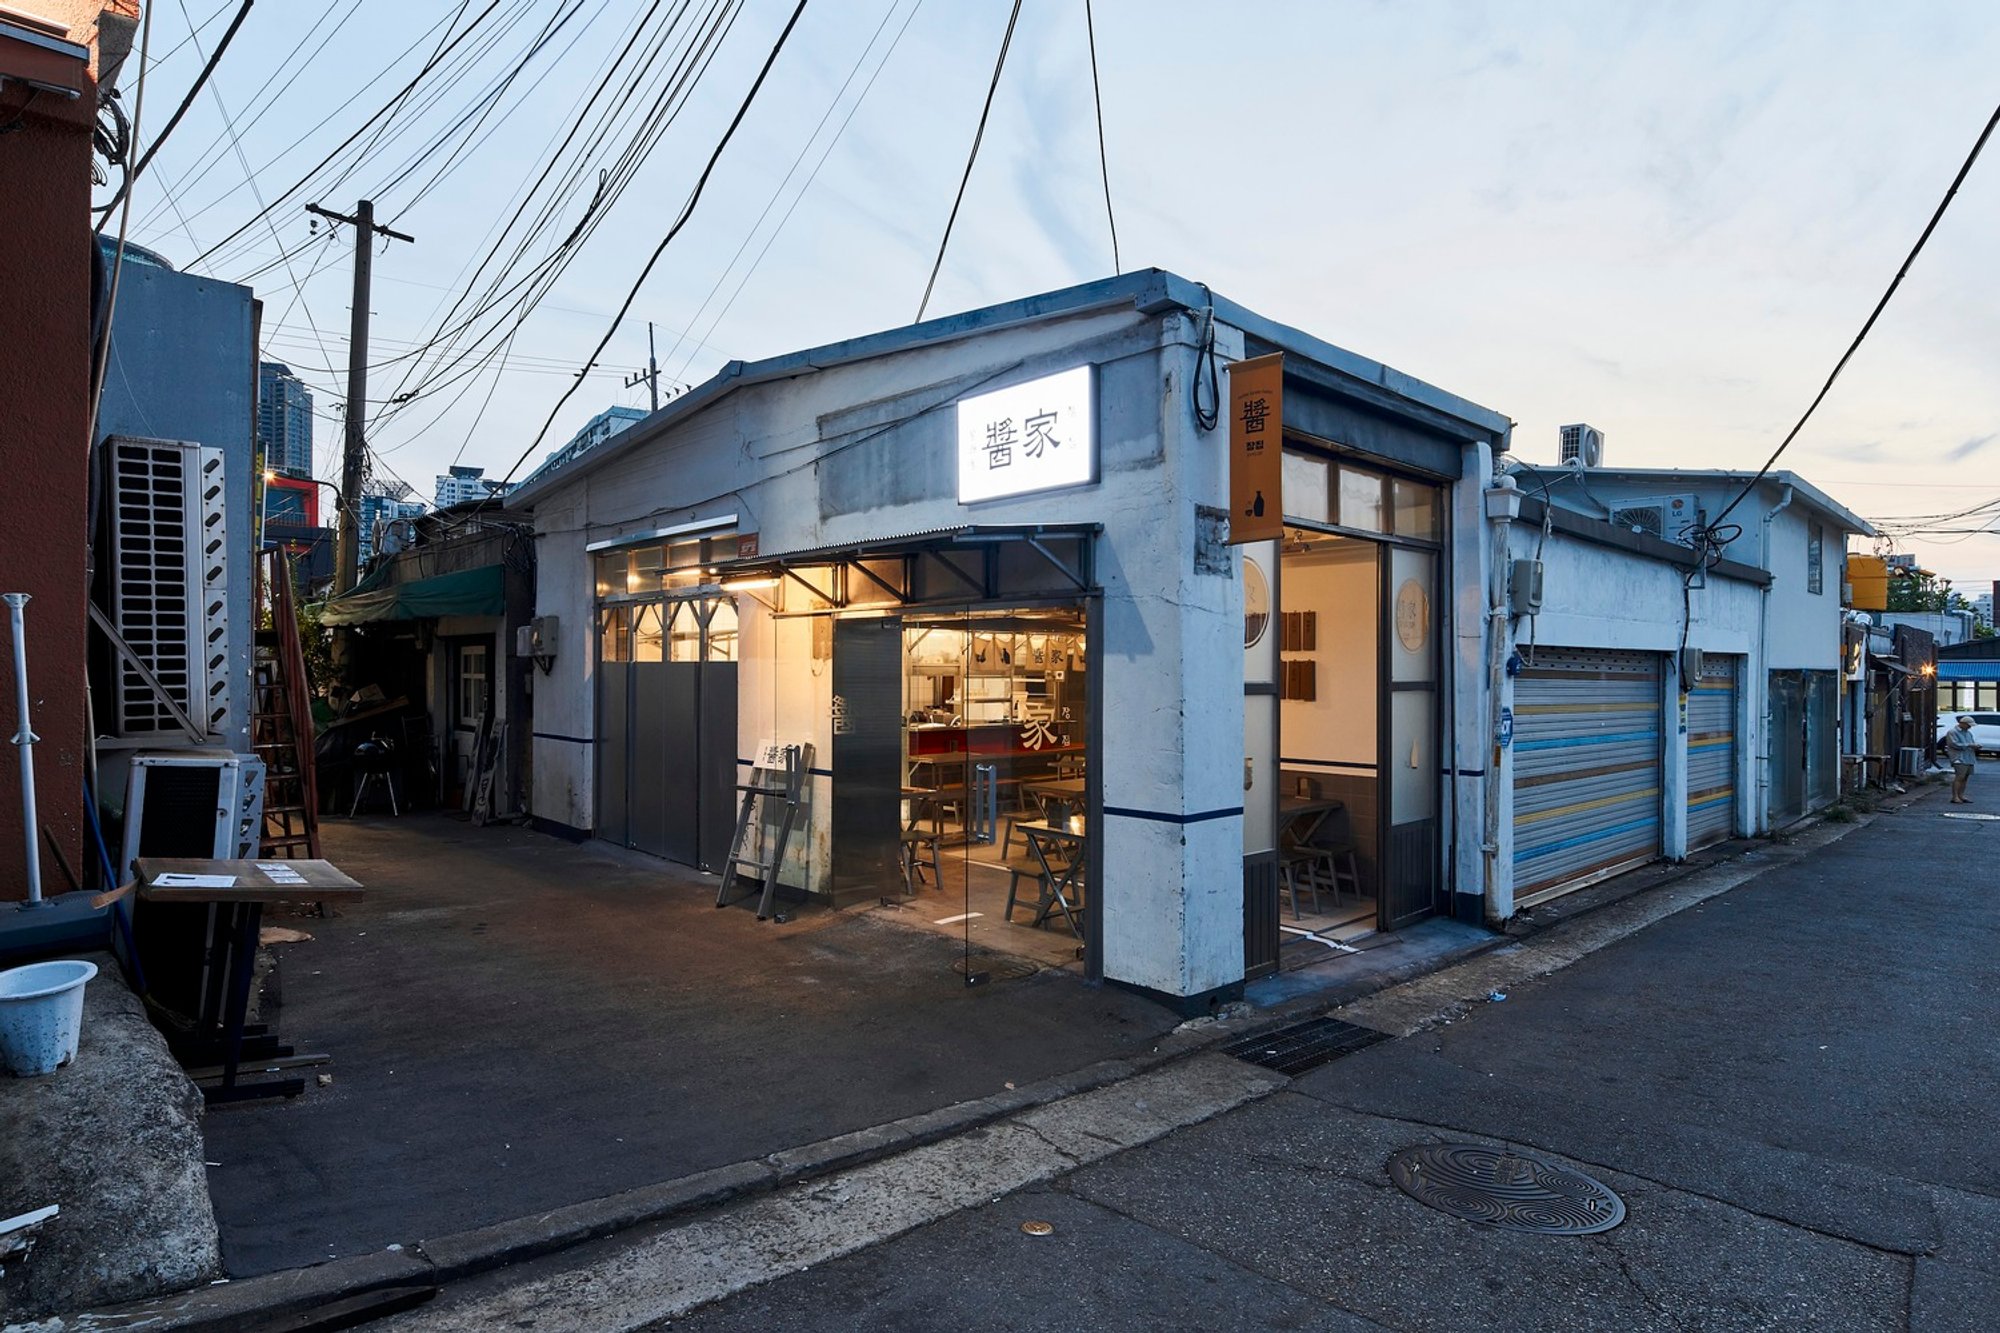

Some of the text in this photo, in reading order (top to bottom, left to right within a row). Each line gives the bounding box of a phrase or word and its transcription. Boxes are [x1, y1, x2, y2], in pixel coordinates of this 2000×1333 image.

[981, 408, 1061, 470] 醬家
[1240, 398, 1271, 434] 醬
[1020, 703, 1058, 750] 家
